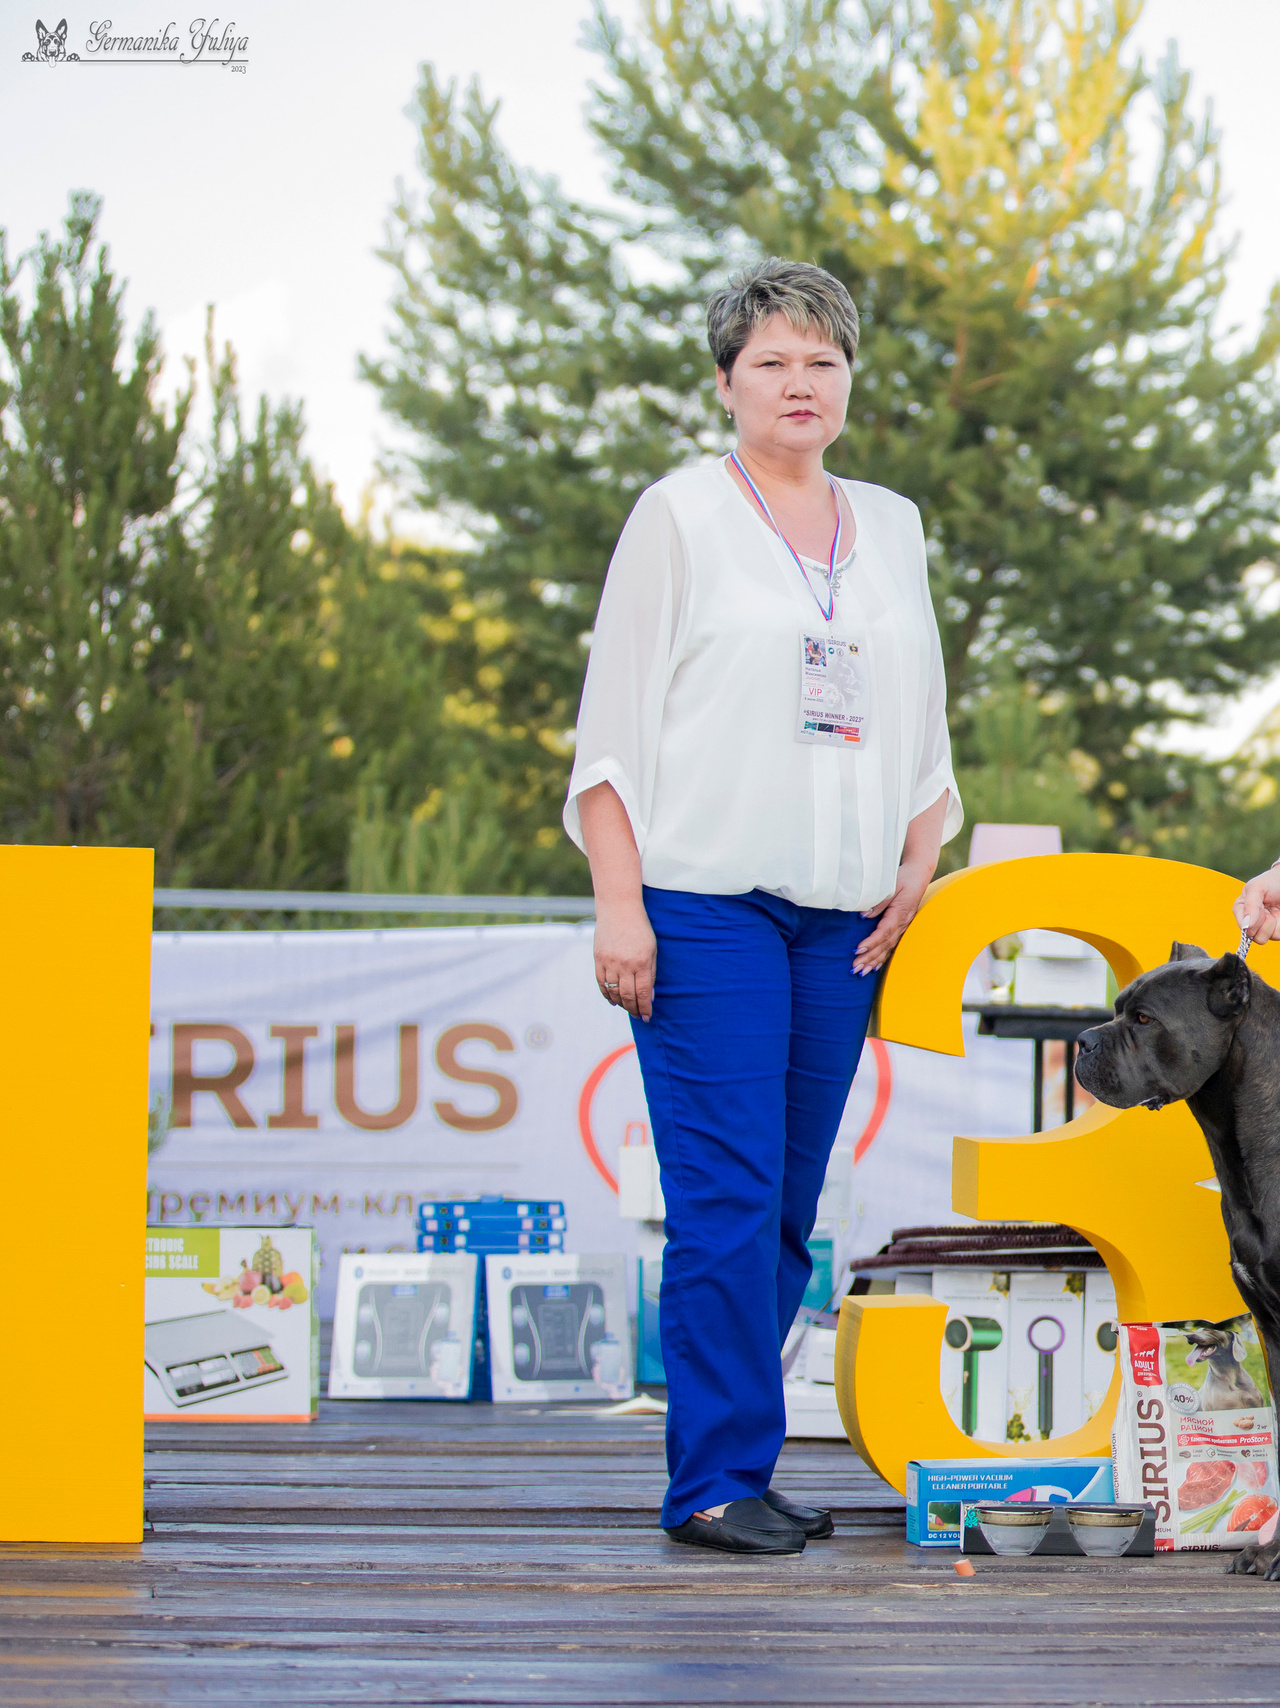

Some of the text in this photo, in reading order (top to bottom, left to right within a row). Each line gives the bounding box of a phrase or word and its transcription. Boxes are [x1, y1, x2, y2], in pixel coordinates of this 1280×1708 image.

[808, 687, 823, 696] VIP
[824, 712, 846, 721] WINNER
[150, 1022, 518, 1132] RIUS
[146, 1237, 185, 1253] TRONIC
[168, 1254, 199, 1270] SCALE
[1134, 1359, 1155, 1371] ADULT
[1174, 1394, 1194, 1404] 40%
[1180, 1416, 1214, 1426] МЯСНОЙ
[1180, 1424, 1214, 1433] РАЦИОН
[1239, 1436, 1269, 1444] ProStor+
[1137, 1399, 1171, 1523] SIRIUS
[927, 1474, 979, 1482] HIGH-POWER
[967, 1482, 1008, 1490] PORTABLE
